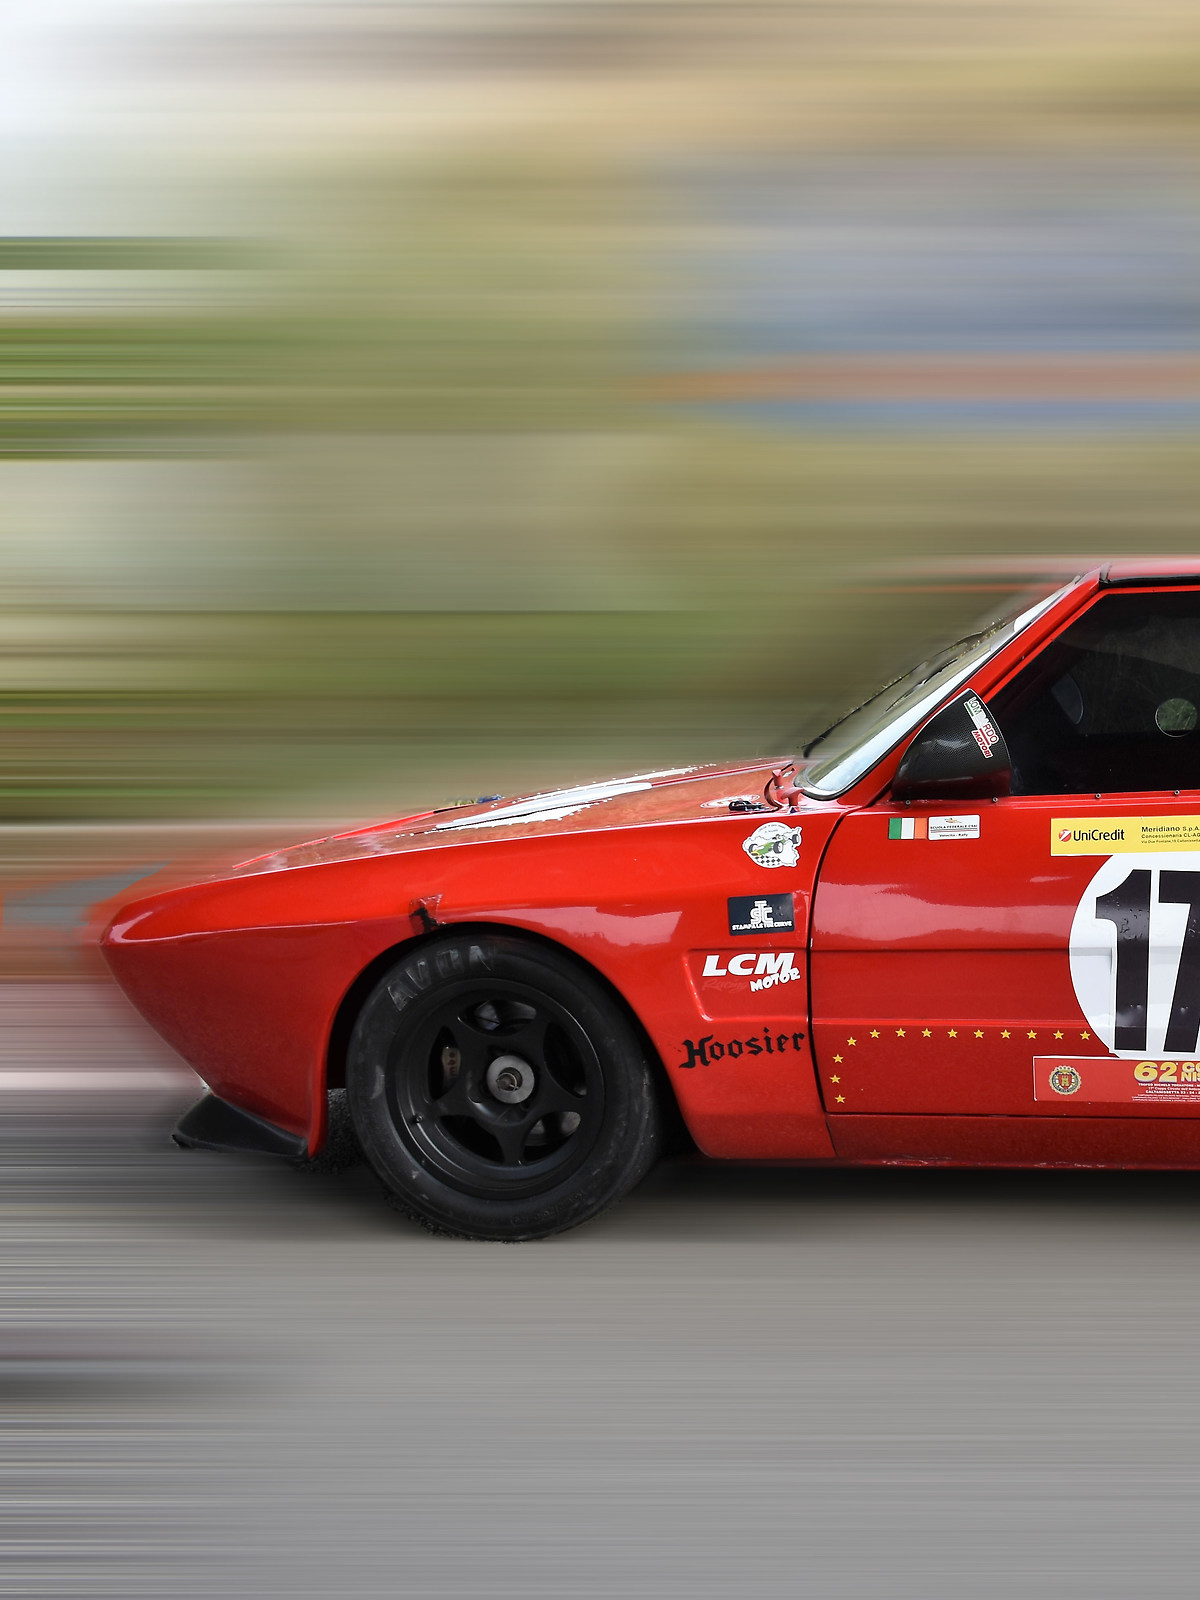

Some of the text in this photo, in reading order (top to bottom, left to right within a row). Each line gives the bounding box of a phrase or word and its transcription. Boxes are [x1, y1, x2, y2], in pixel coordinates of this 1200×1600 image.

[968, 697, 999, 743] LOMRDO
[972, 730, 992, 758] MOTORI
[1073, 828, 1125, 841] UniCredit
[702, 952, 795, 977] LCM
[750, 968, 801, 992] MOTOR
[678, 1027, 806, 1069] Hoosier
